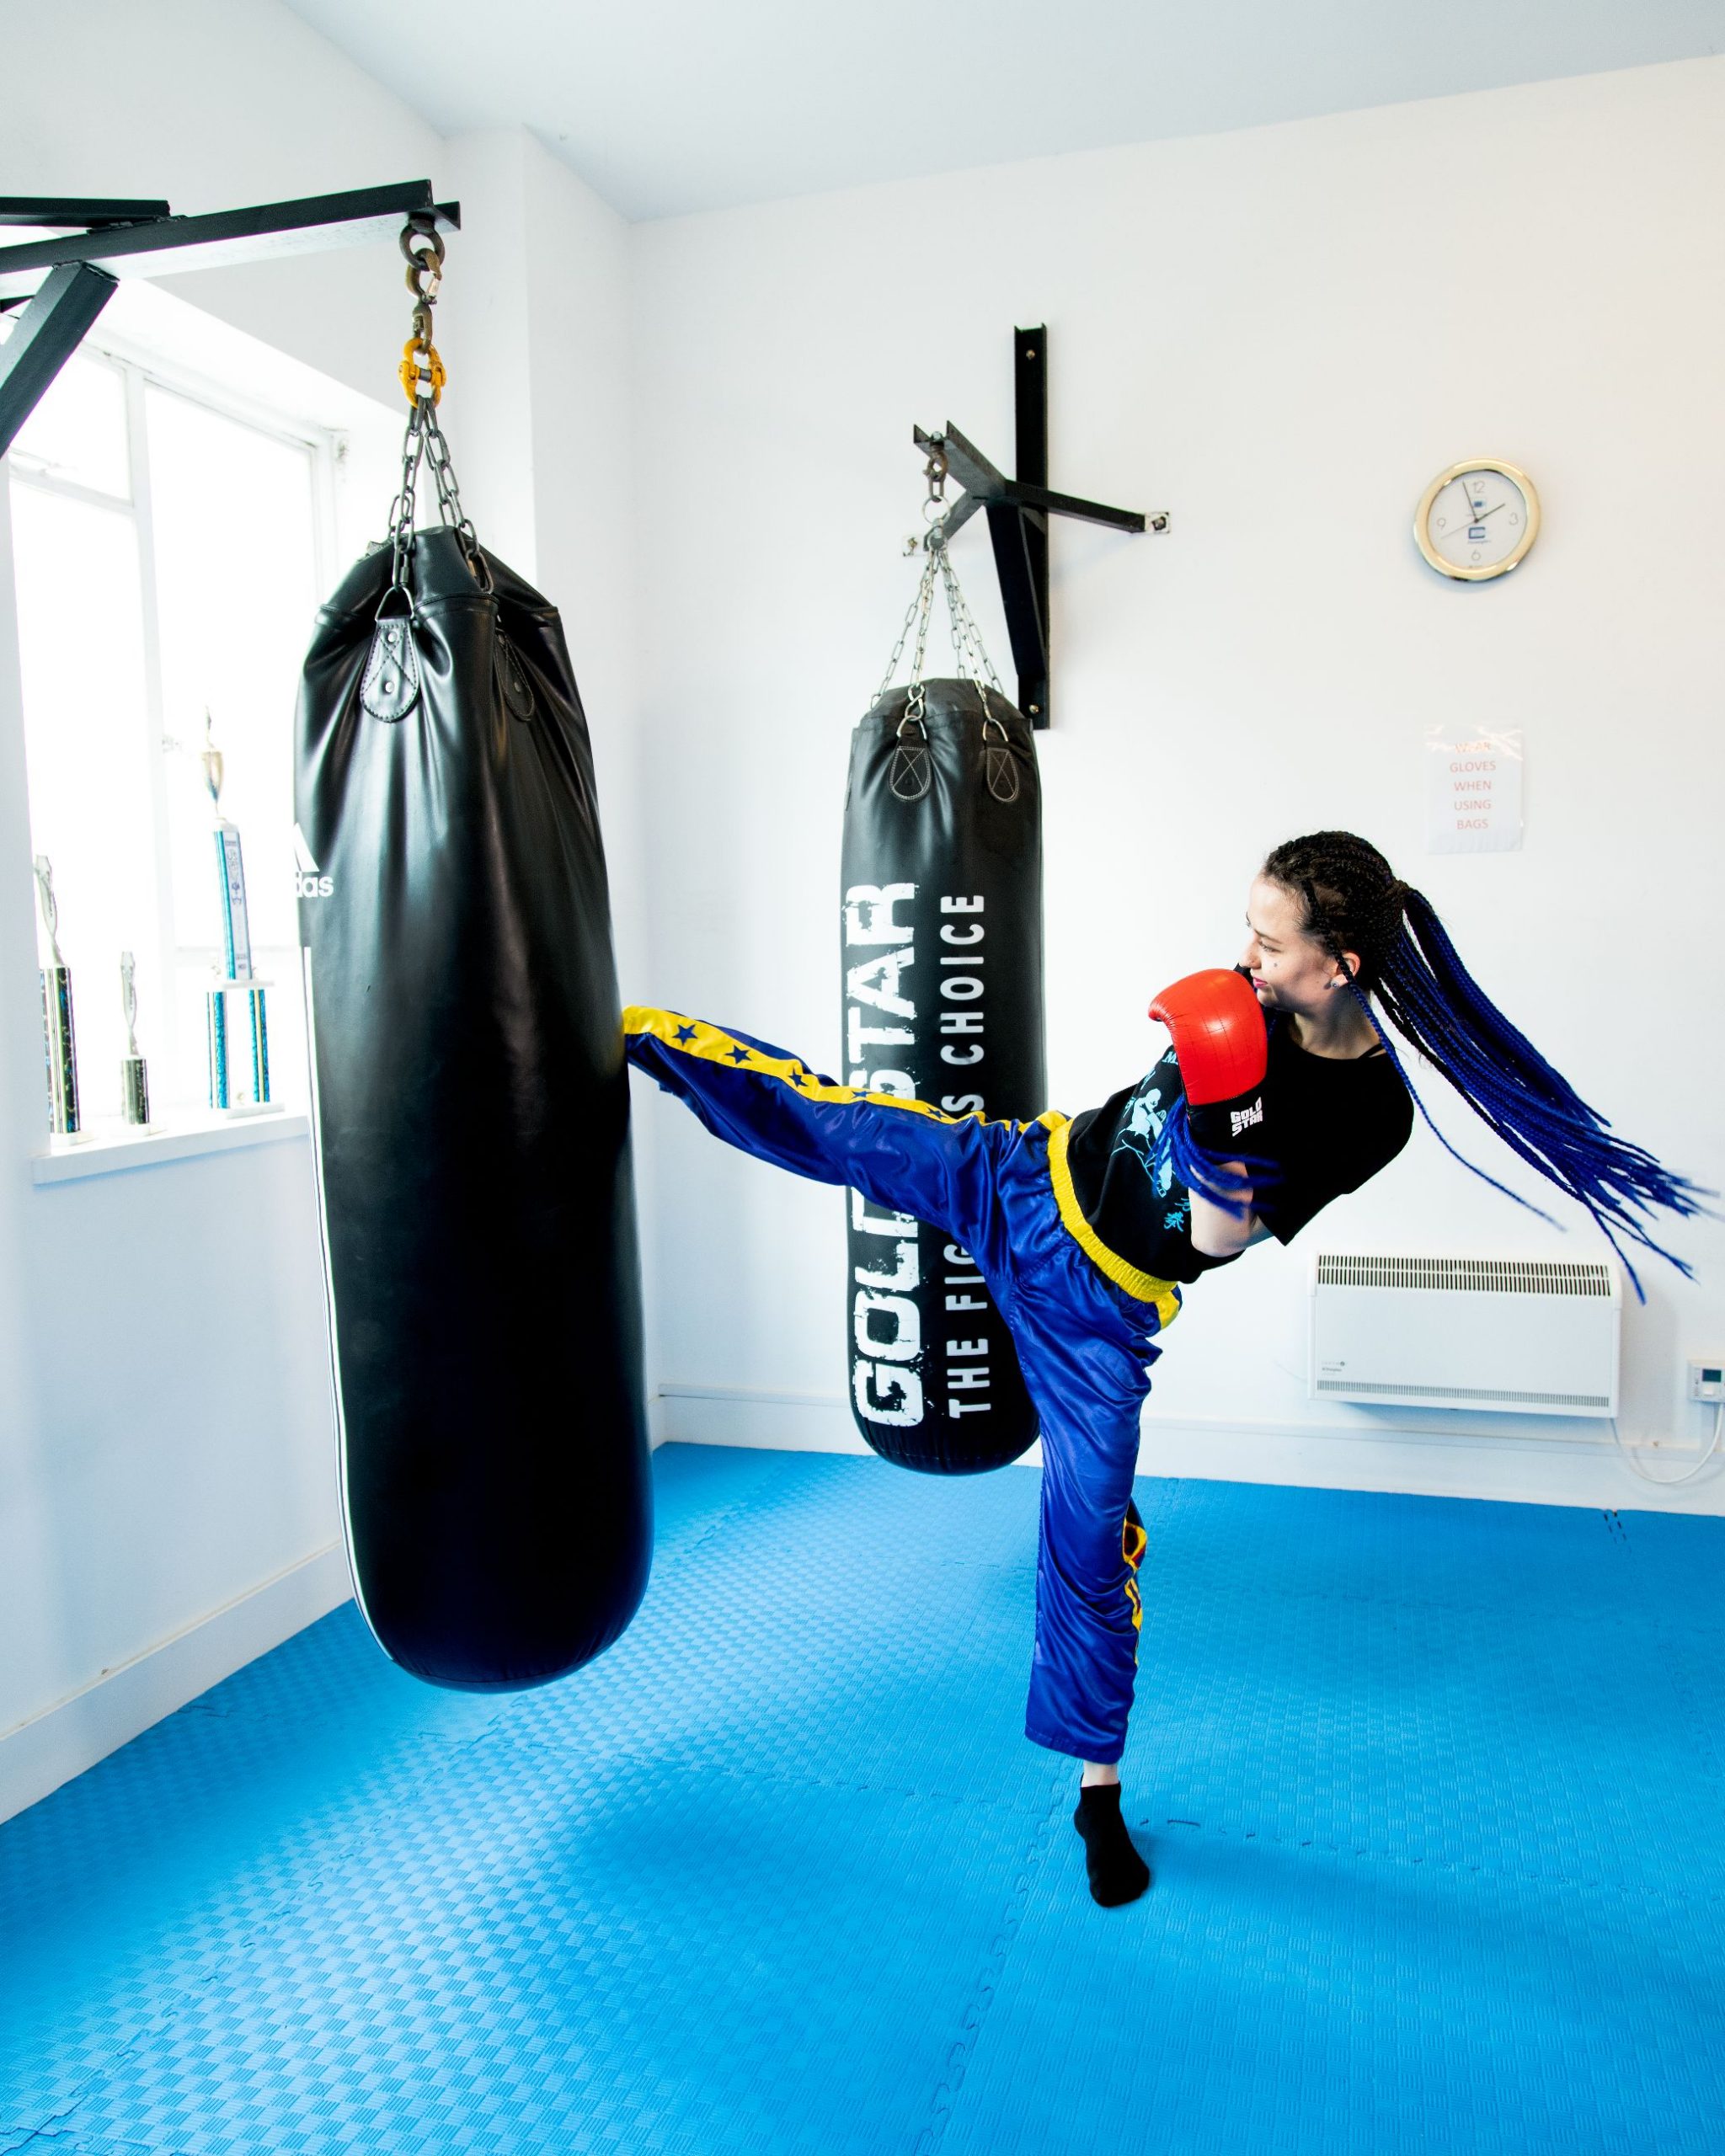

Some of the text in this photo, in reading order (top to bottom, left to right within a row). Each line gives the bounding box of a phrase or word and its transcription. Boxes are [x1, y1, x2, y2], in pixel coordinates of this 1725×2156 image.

[1472, 481, 1486, 494] 12
[1436, 517, 1446, 531] 9
[1509, 512, 1519, 526] 3
[1471, 550, 1482, 562] 6
[1449, 760, 1497, 773] GLOVES
[1454, 780, 1492, 792] WHEN
[1454, 799, 1492, 811] USING
[1456, 819, 1489, 830] BAGS
[939, 894, 985, 1065] CHOICE
[1230, 1096, 1263, 1123] GOLD
[1231, 1109, 1263, 1137] STAR
[945, 1338, 991, 1419] THE
